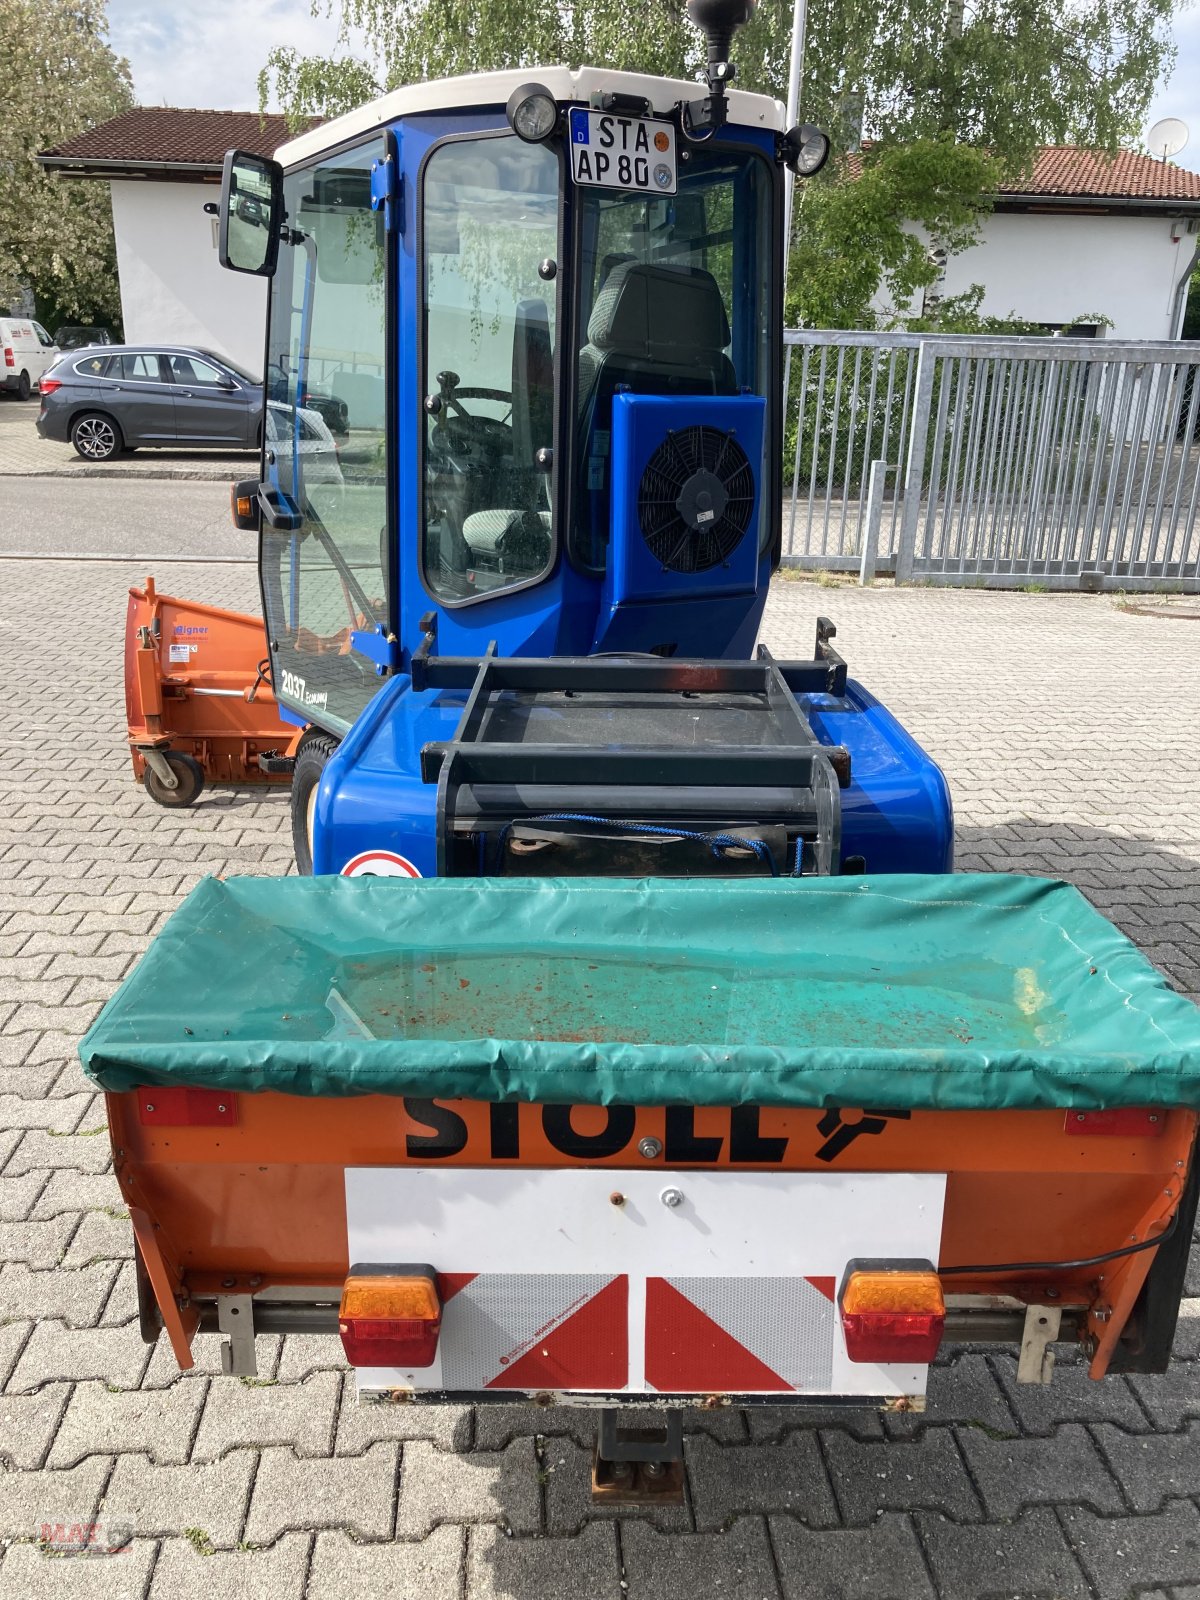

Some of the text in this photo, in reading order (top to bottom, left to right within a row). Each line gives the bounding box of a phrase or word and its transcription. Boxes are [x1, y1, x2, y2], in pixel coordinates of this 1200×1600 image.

[577, 132, 584, 141] D
[599, 116, 649, 153] STA
[577, 149, 649, 187] AP 80
[281, 669, 306, 702] 2037
